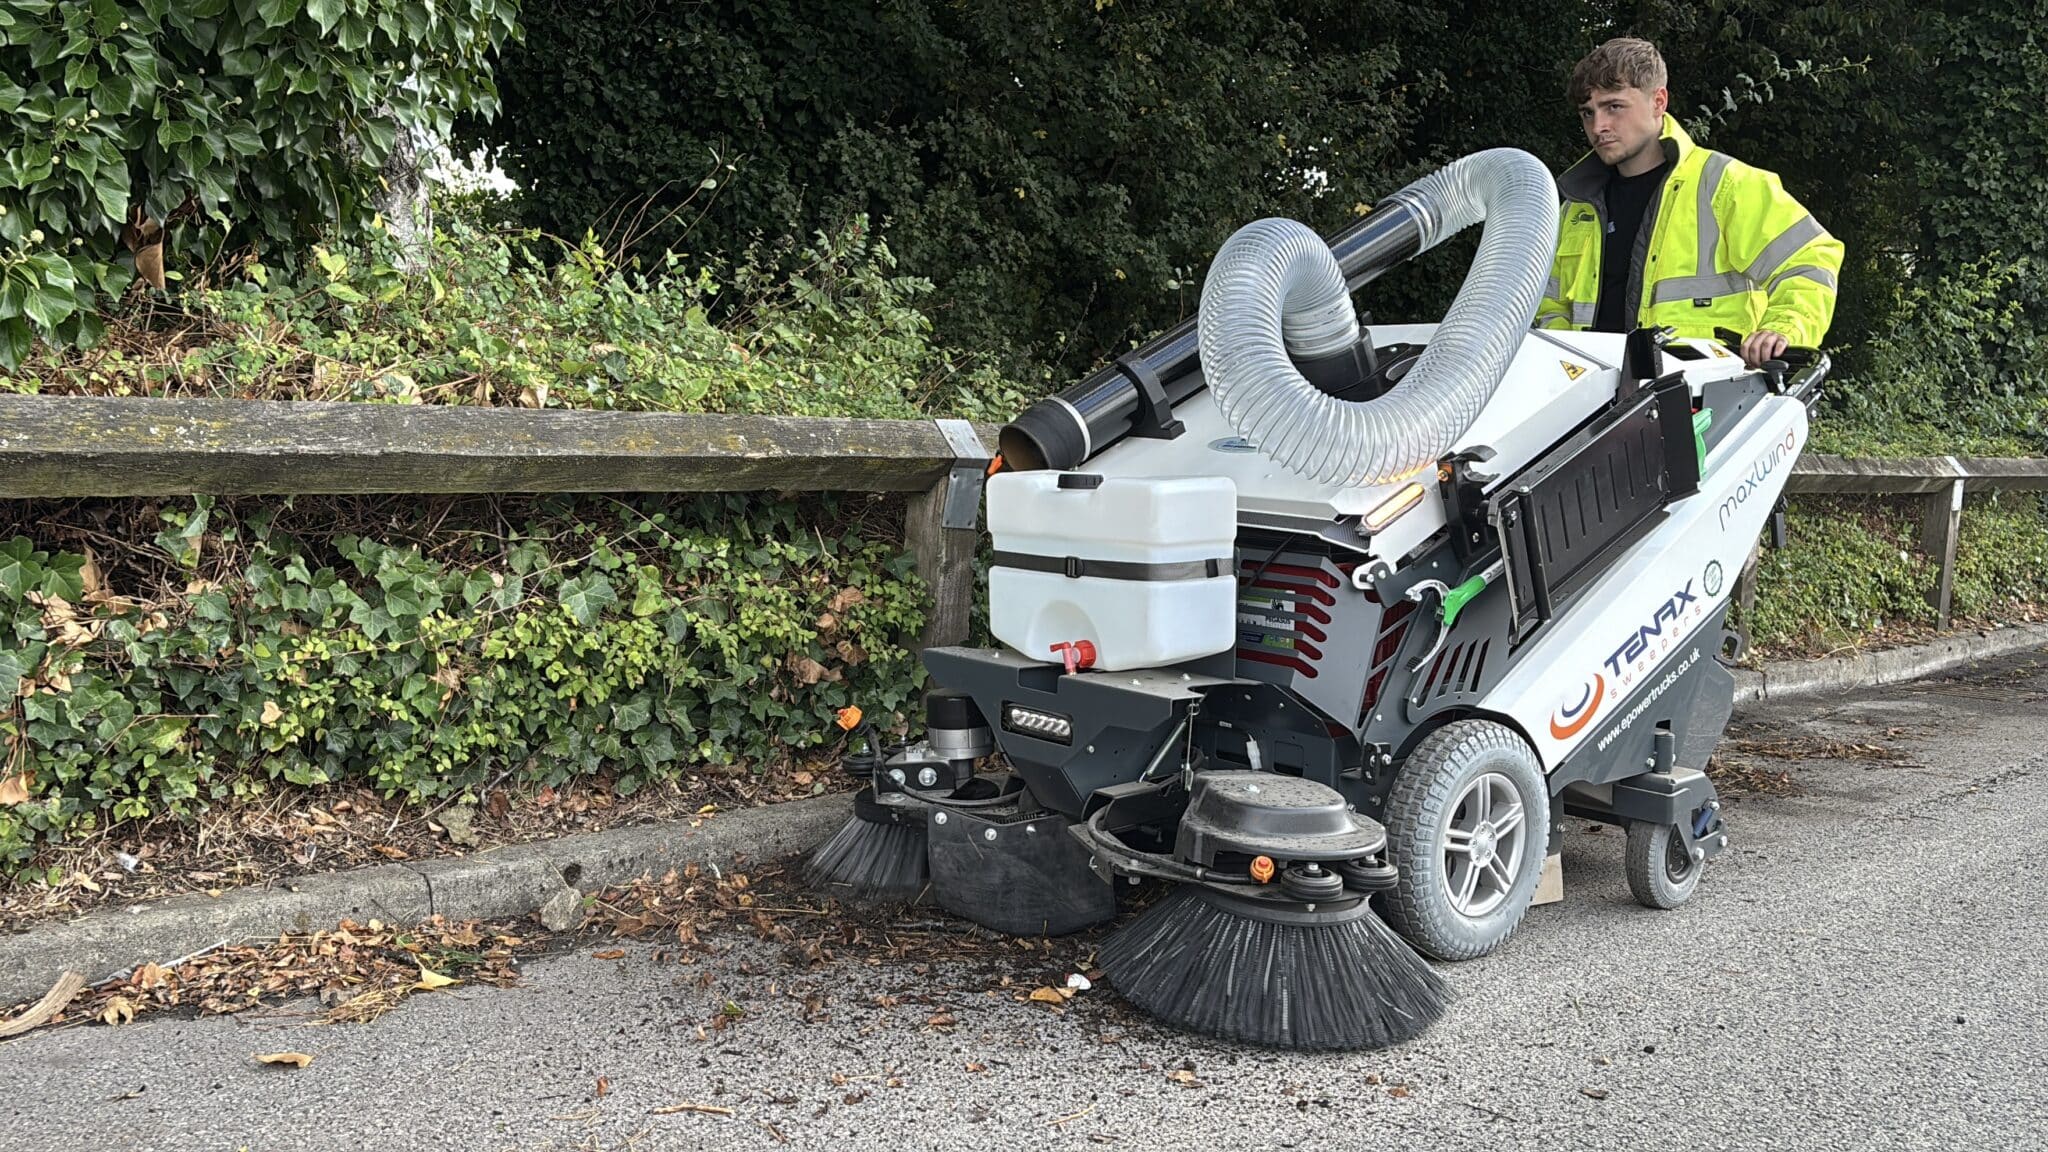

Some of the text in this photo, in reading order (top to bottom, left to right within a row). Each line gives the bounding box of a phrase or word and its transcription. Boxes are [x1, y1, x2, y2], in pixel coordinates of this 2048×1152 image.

[1604, 577, 1697, 678] TENAX
[1610, 605, 1701, 699] sweepers
[1597, 647, 1700, 752] www.epowertrucks.co.uk
